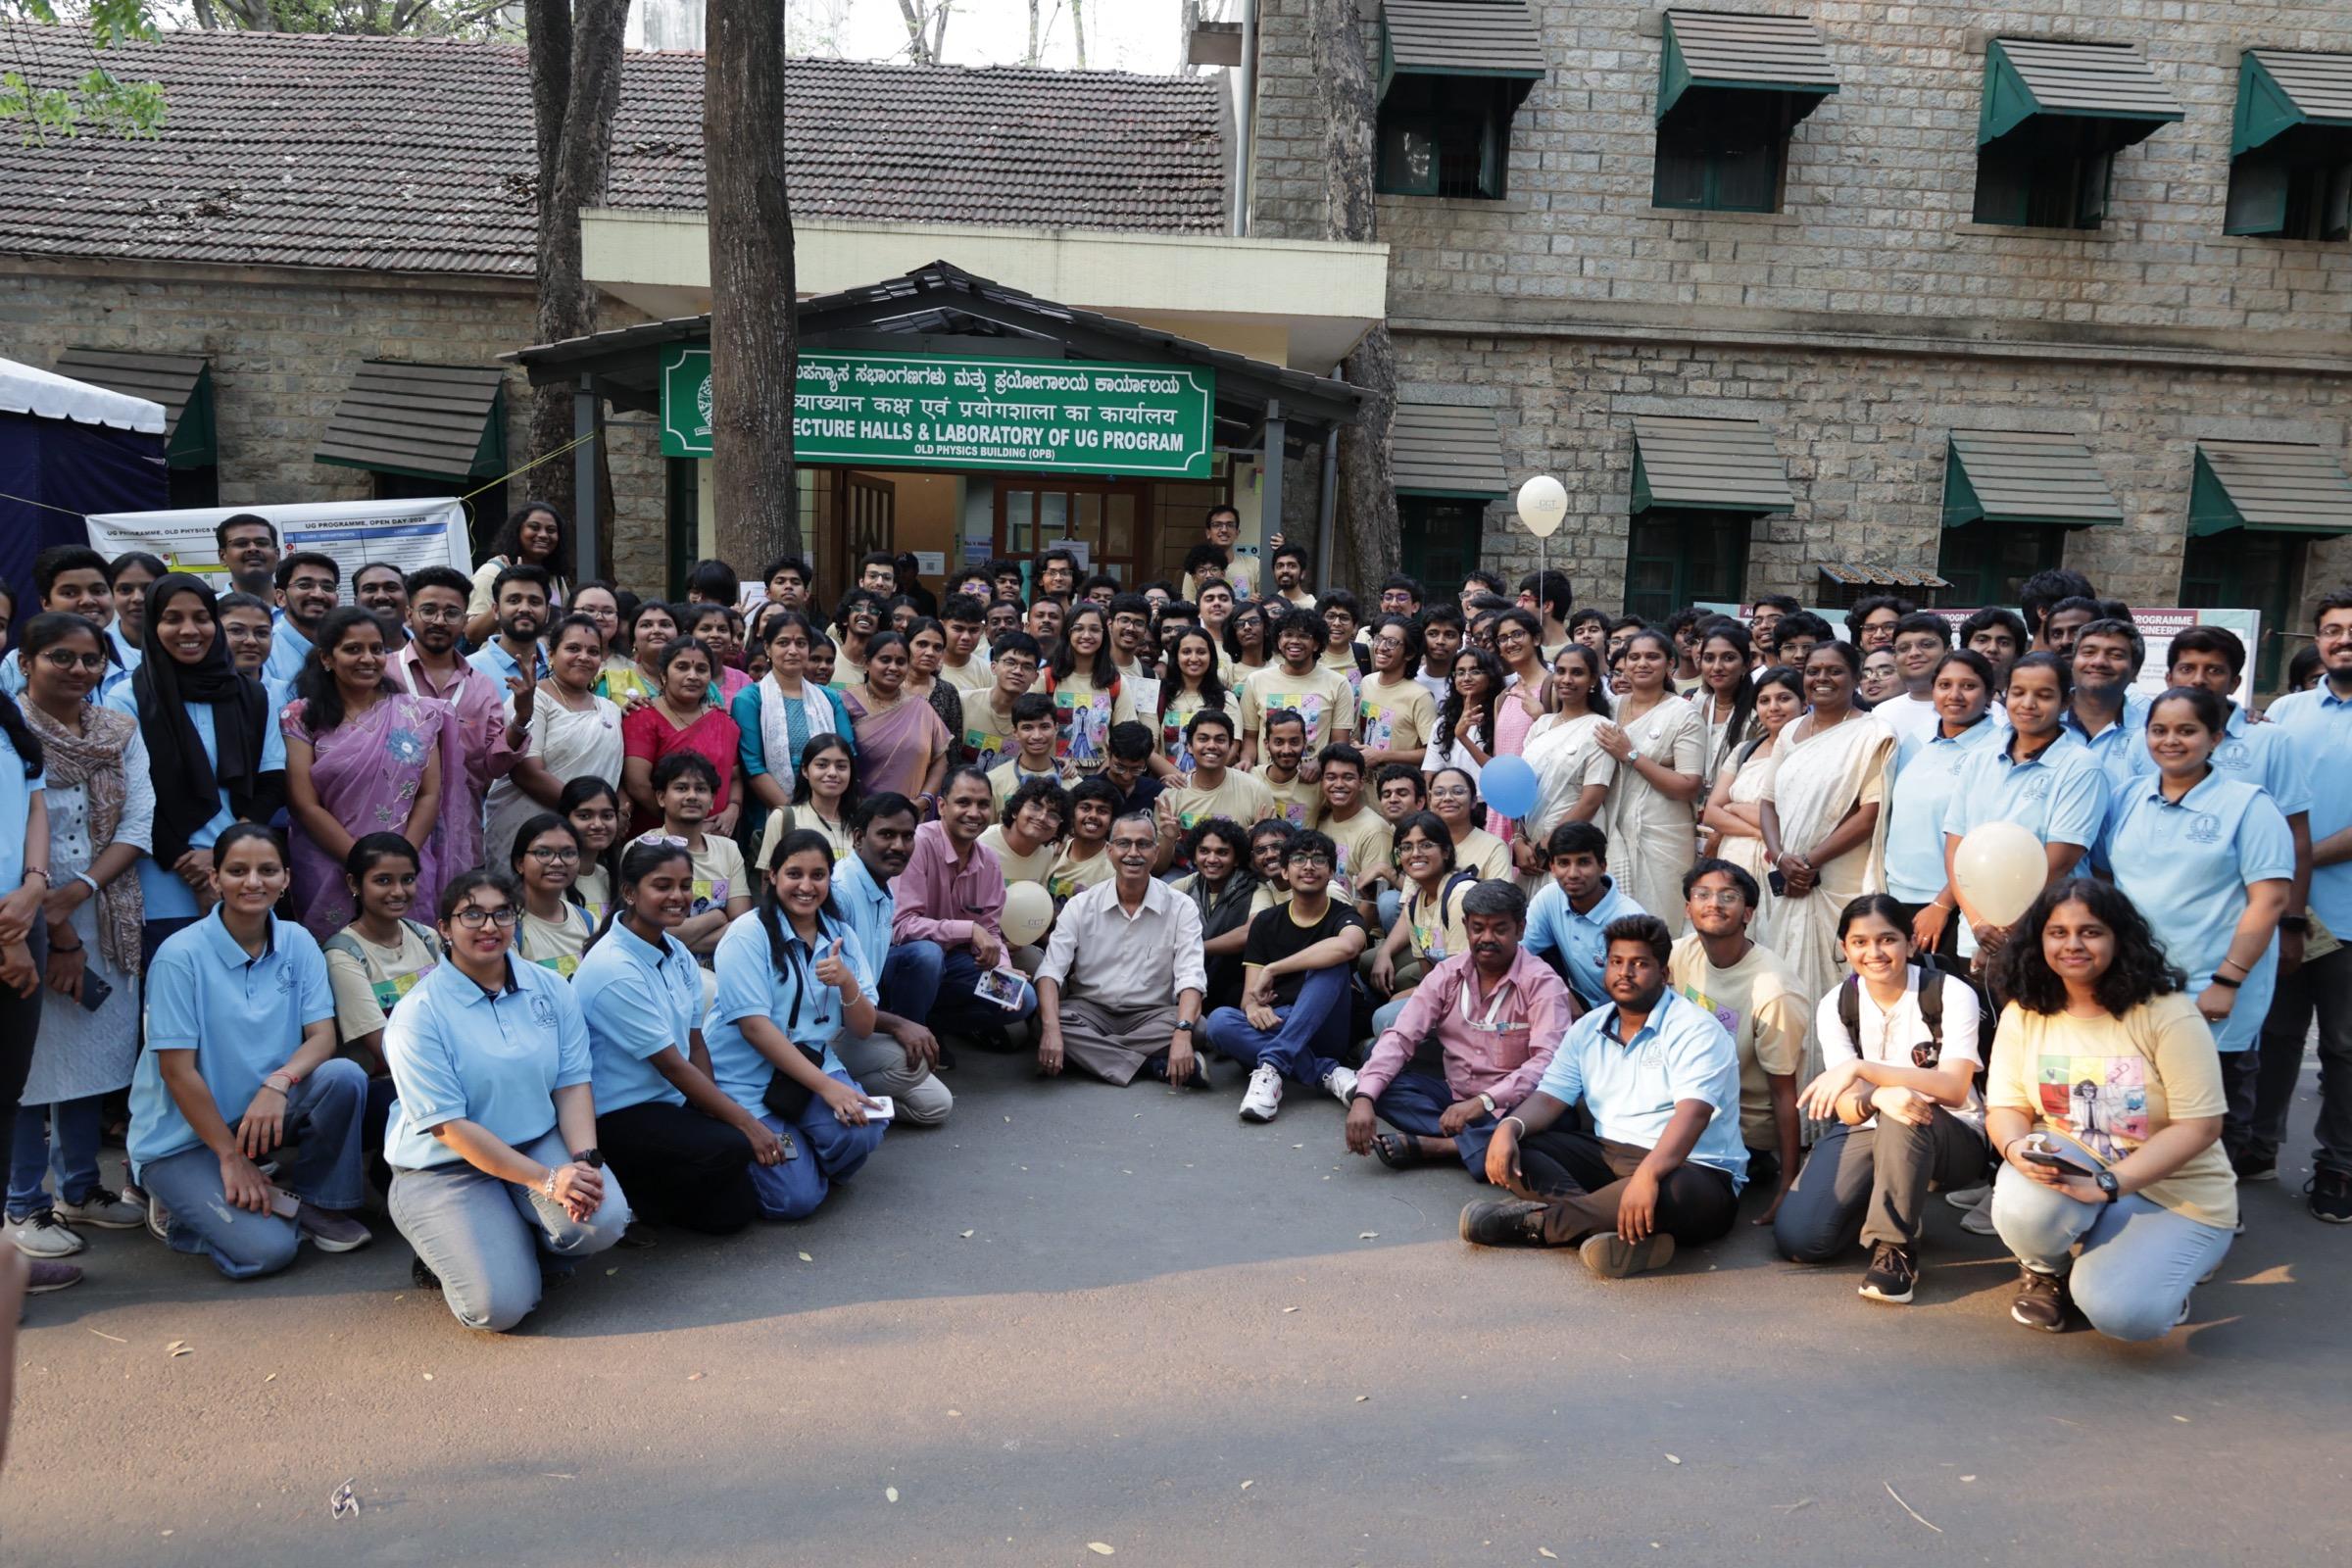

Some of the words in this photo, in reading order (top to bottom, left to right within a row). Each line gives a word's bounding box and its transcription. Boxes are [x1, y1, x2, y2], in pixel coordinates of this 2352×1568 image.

[954, 368, 987, 392] ಮತ್ತು
[995, 369, 1089, 394] ಪ್ರಯೋಗಾಲಯ
[871, 397, 914, 416] कक्ष
[920, 396, 952, 419] एवं
[958, 396, 1057, 421] प्रयोगशाला
[1063, 405, 1092, 421] का
[1098, 402, 1178, 425] कार्यालय
[793, 418, 856, 438] ECTURE
[860, 420, 913, 440] HALLS
[918, 423, 930, 441] &
[935, 423, 1044, 445] LABORATORY
[1049, 428, 1070, 447] OF
[1075, 429, 1099, 448] UG
[1102, 431, 1184, 451] PROGRAM
[914, 444, 934, 454] OLD
[936, 445, 978, 456] PHYSICS
[980, 446, 1026, 458] BUILDING
[1028, 449, 1054, 461] (OPB)
[318, 520, 368, 529] PROGRAMME,
